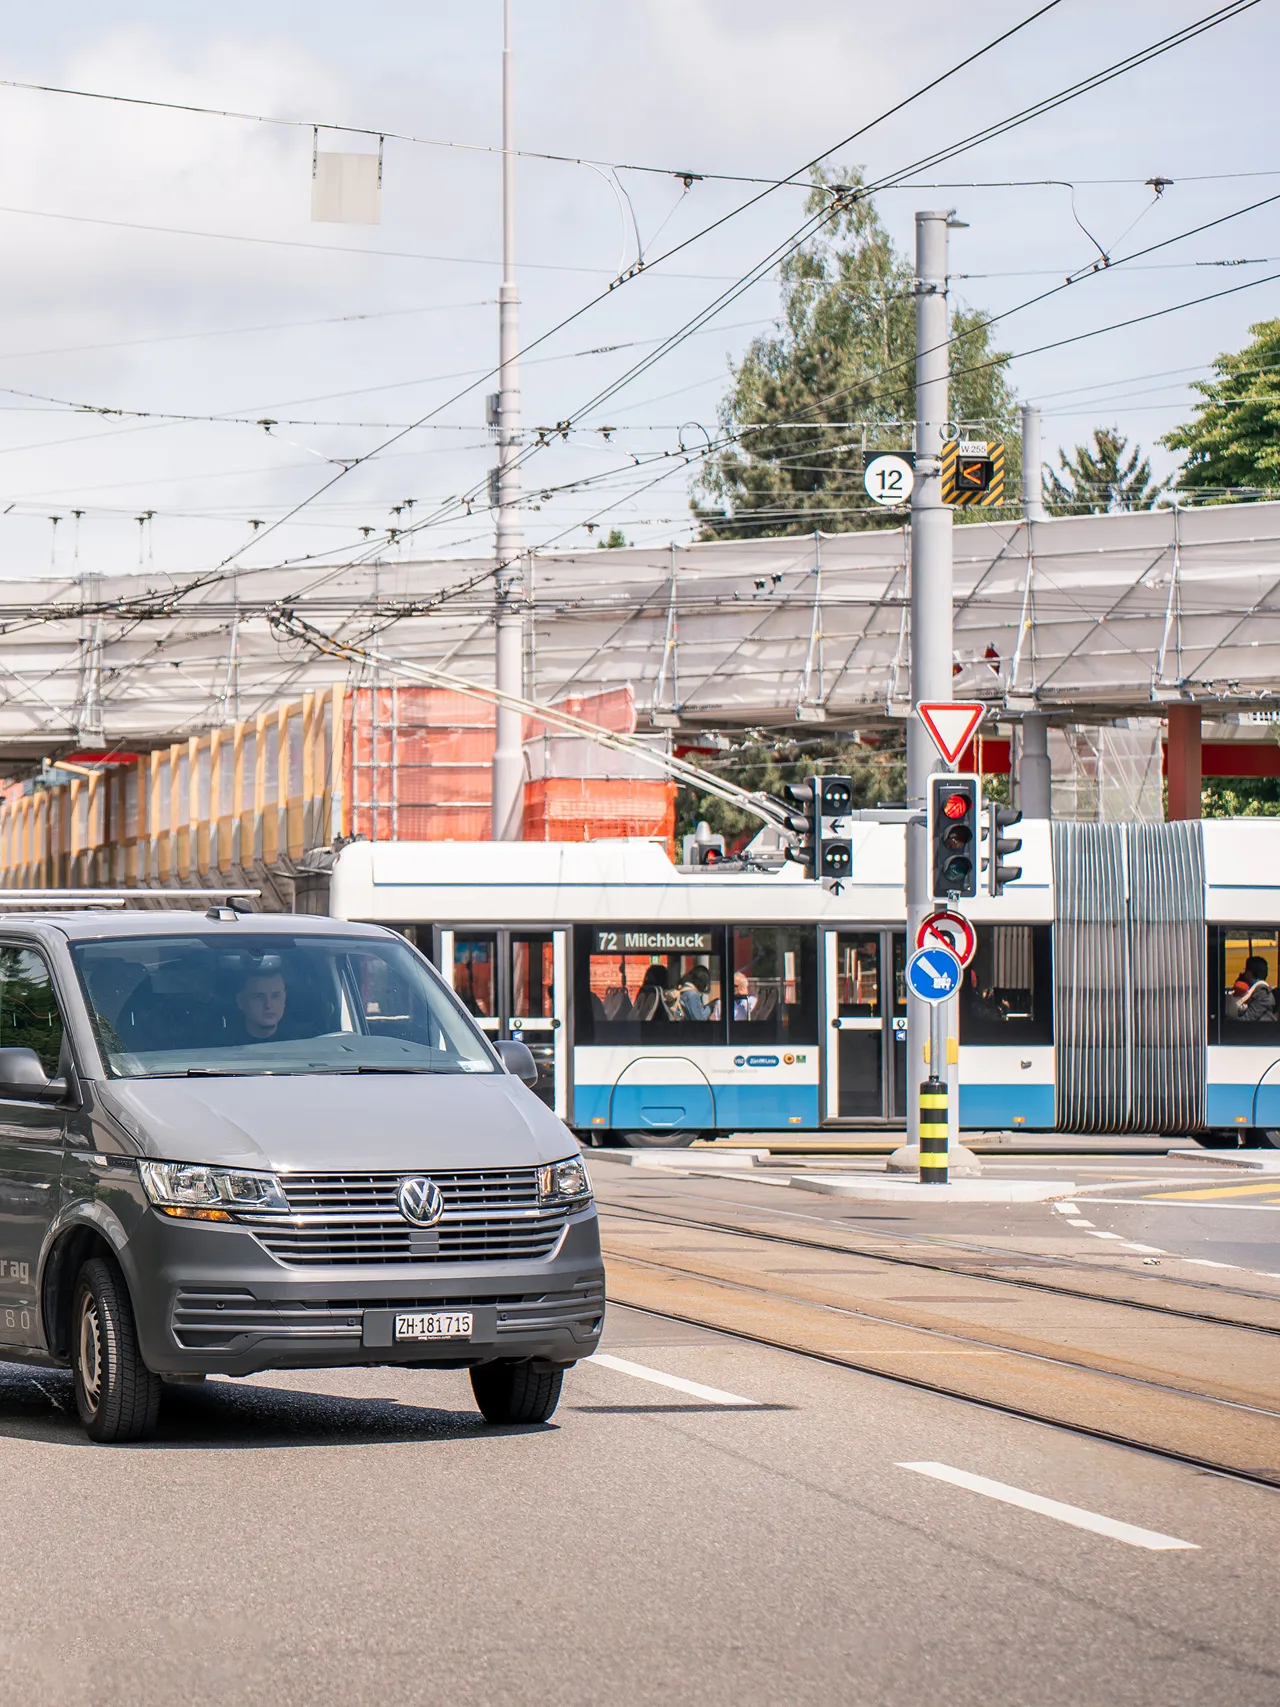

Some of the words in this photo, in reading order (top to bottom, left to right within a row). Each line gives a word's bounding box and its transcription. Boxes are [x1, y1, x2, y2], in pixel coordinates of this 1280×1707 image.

[961, 445, 970, 453] W
[875, 469, 903, 491] 12
[598, 932, 618, 951] 72
[624, 932, 704, 948] Milchbuck
[10, 1261, 30, 1285] ag
[5, 1309, 31, 1330] 80
